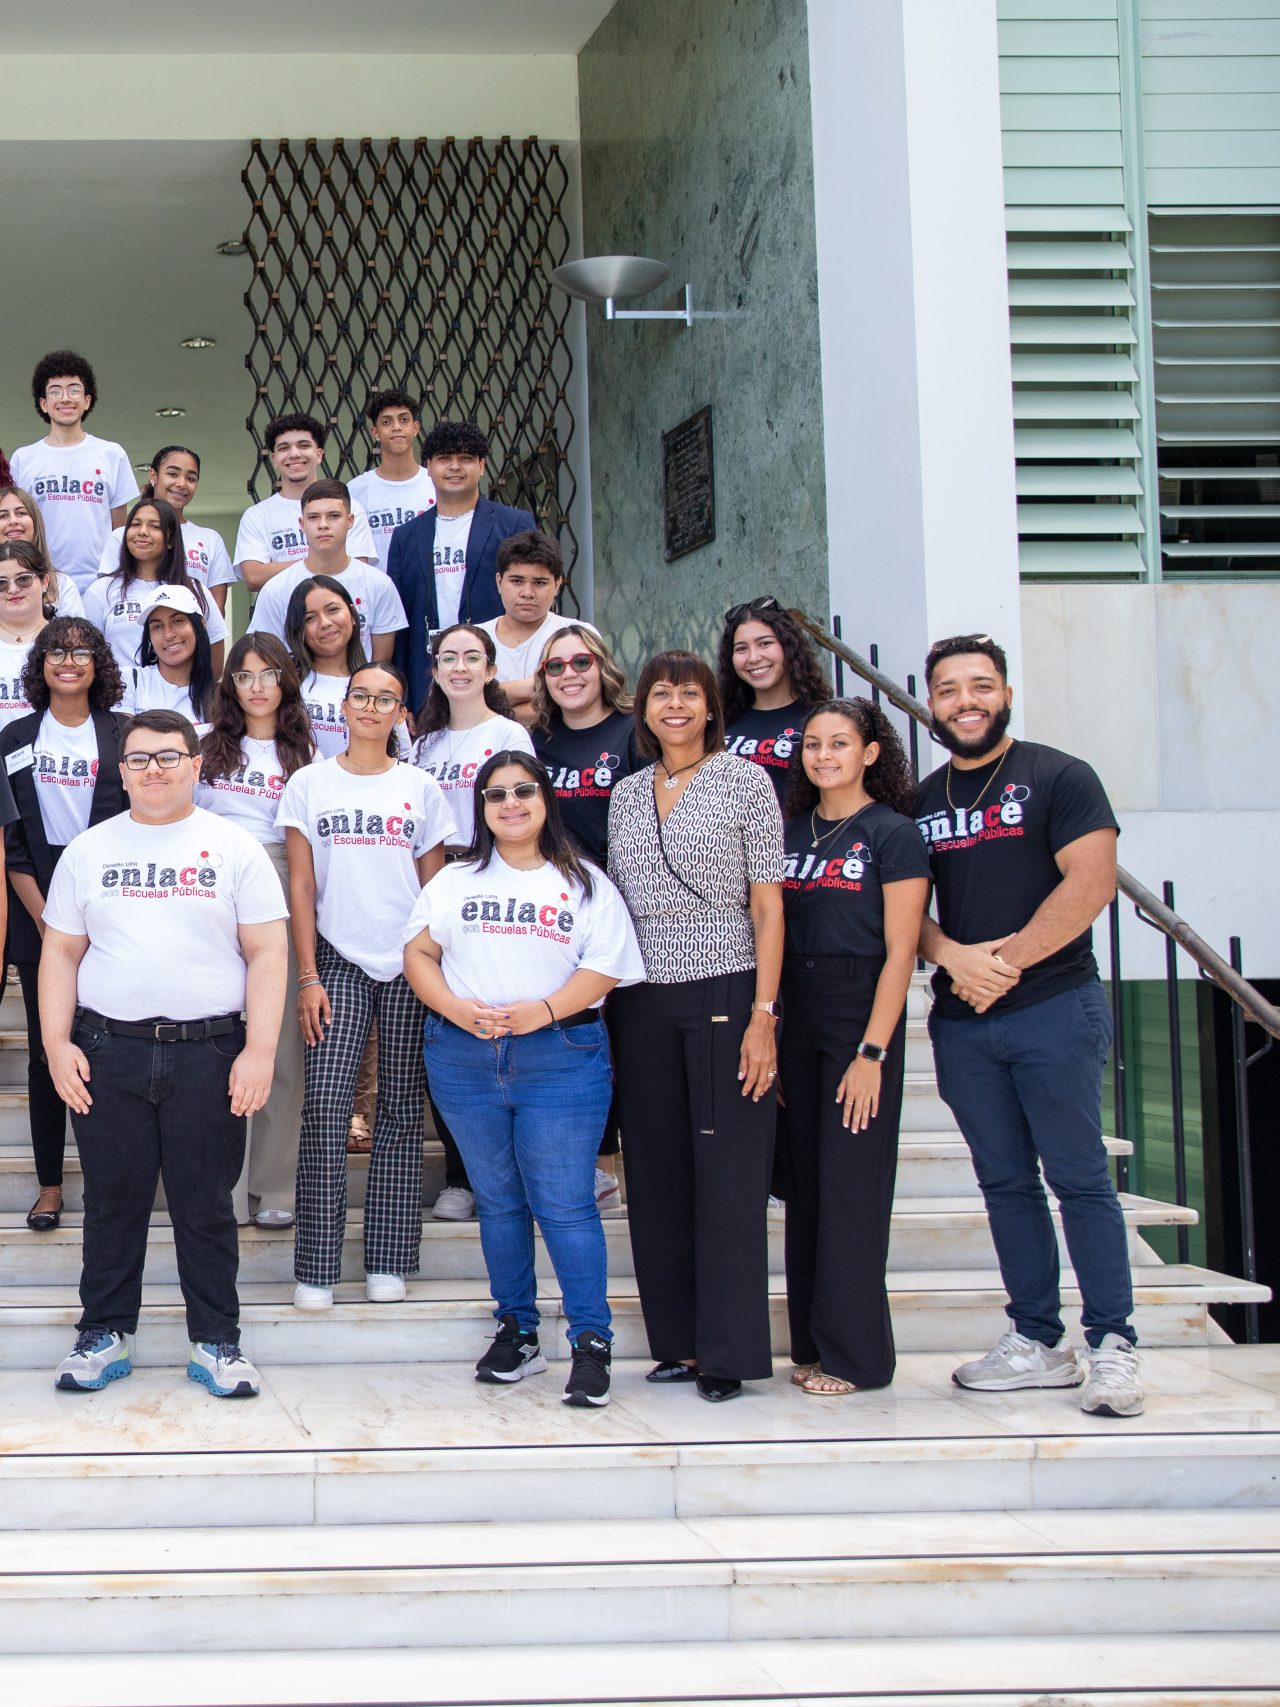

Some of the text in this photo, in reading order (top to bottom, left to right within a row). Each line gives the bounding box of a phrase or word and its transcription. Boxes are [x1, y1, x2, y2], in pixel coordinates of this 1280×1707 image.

[35, 475, 104, 496] enlace
[40, 774, 80, 786] Escuelas
[574, 786, 610, 797] Públicas
[317, 808, 414, 839] enlace
[334, 835, 376, 845] Escuelas
[978, 826, 1024, 842] Públicas
[102, 863, 216, 888] enlace
[816, 876, 862, 891] Públicas
[122, 887, 168, 898] Escuelas
[172, 886, 216, 898] Públicas
[462, 898, 574, 932] enlace
[482, 922, 527, 934] Escuelas
[530, 924, 571, 945] Públicas
